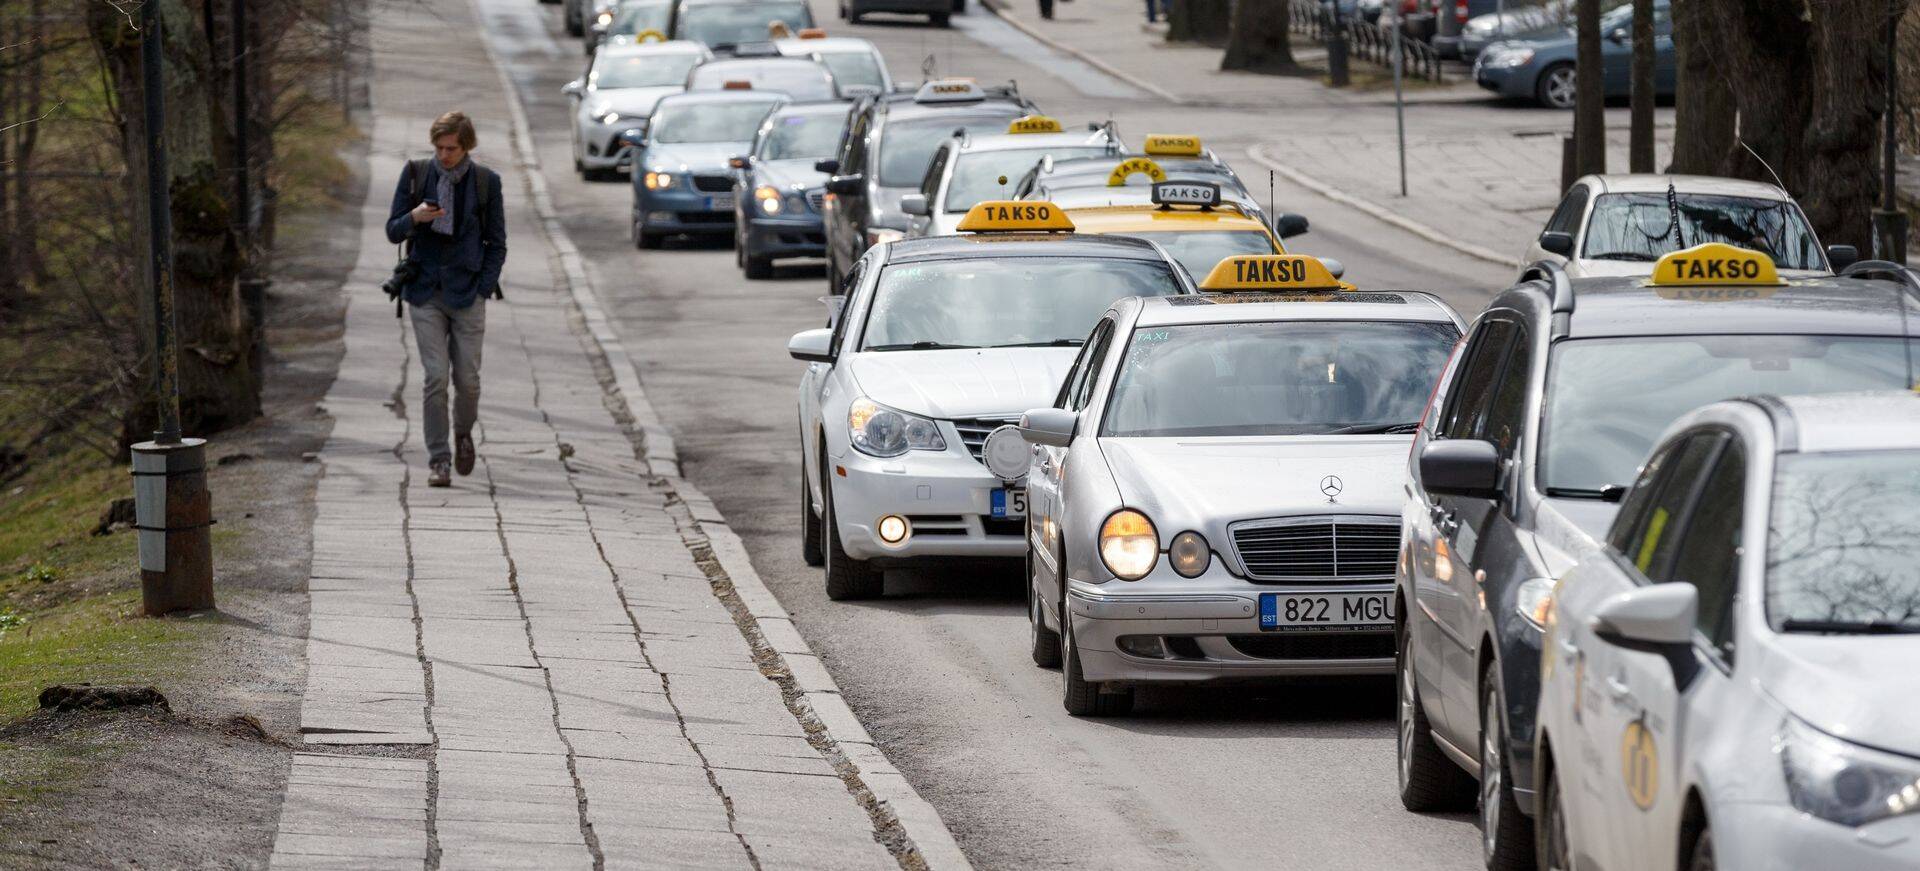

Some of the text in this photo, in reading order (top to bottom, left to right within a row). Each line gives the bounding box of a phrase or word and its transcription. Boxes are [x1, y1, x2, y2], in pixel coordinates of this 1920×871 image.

[1016, 121, 1054, 131] TAKSO
[1153, 138, 1194, 147] TAKSO
[1113, 160, 1160, 178] TAKSO
[1160, 188, 1211, 199] TAKSO
[984, 206, 1050, 220] TAKSO
[1234, 259, 1306, 283] TAKSO
[1672, 259, 1760, 279] TAKSO
[1135, 332, 1169, 341] TAXI
[1285, 597, 1330, 622] 822
[1262, 614, 1276, 623] EST
